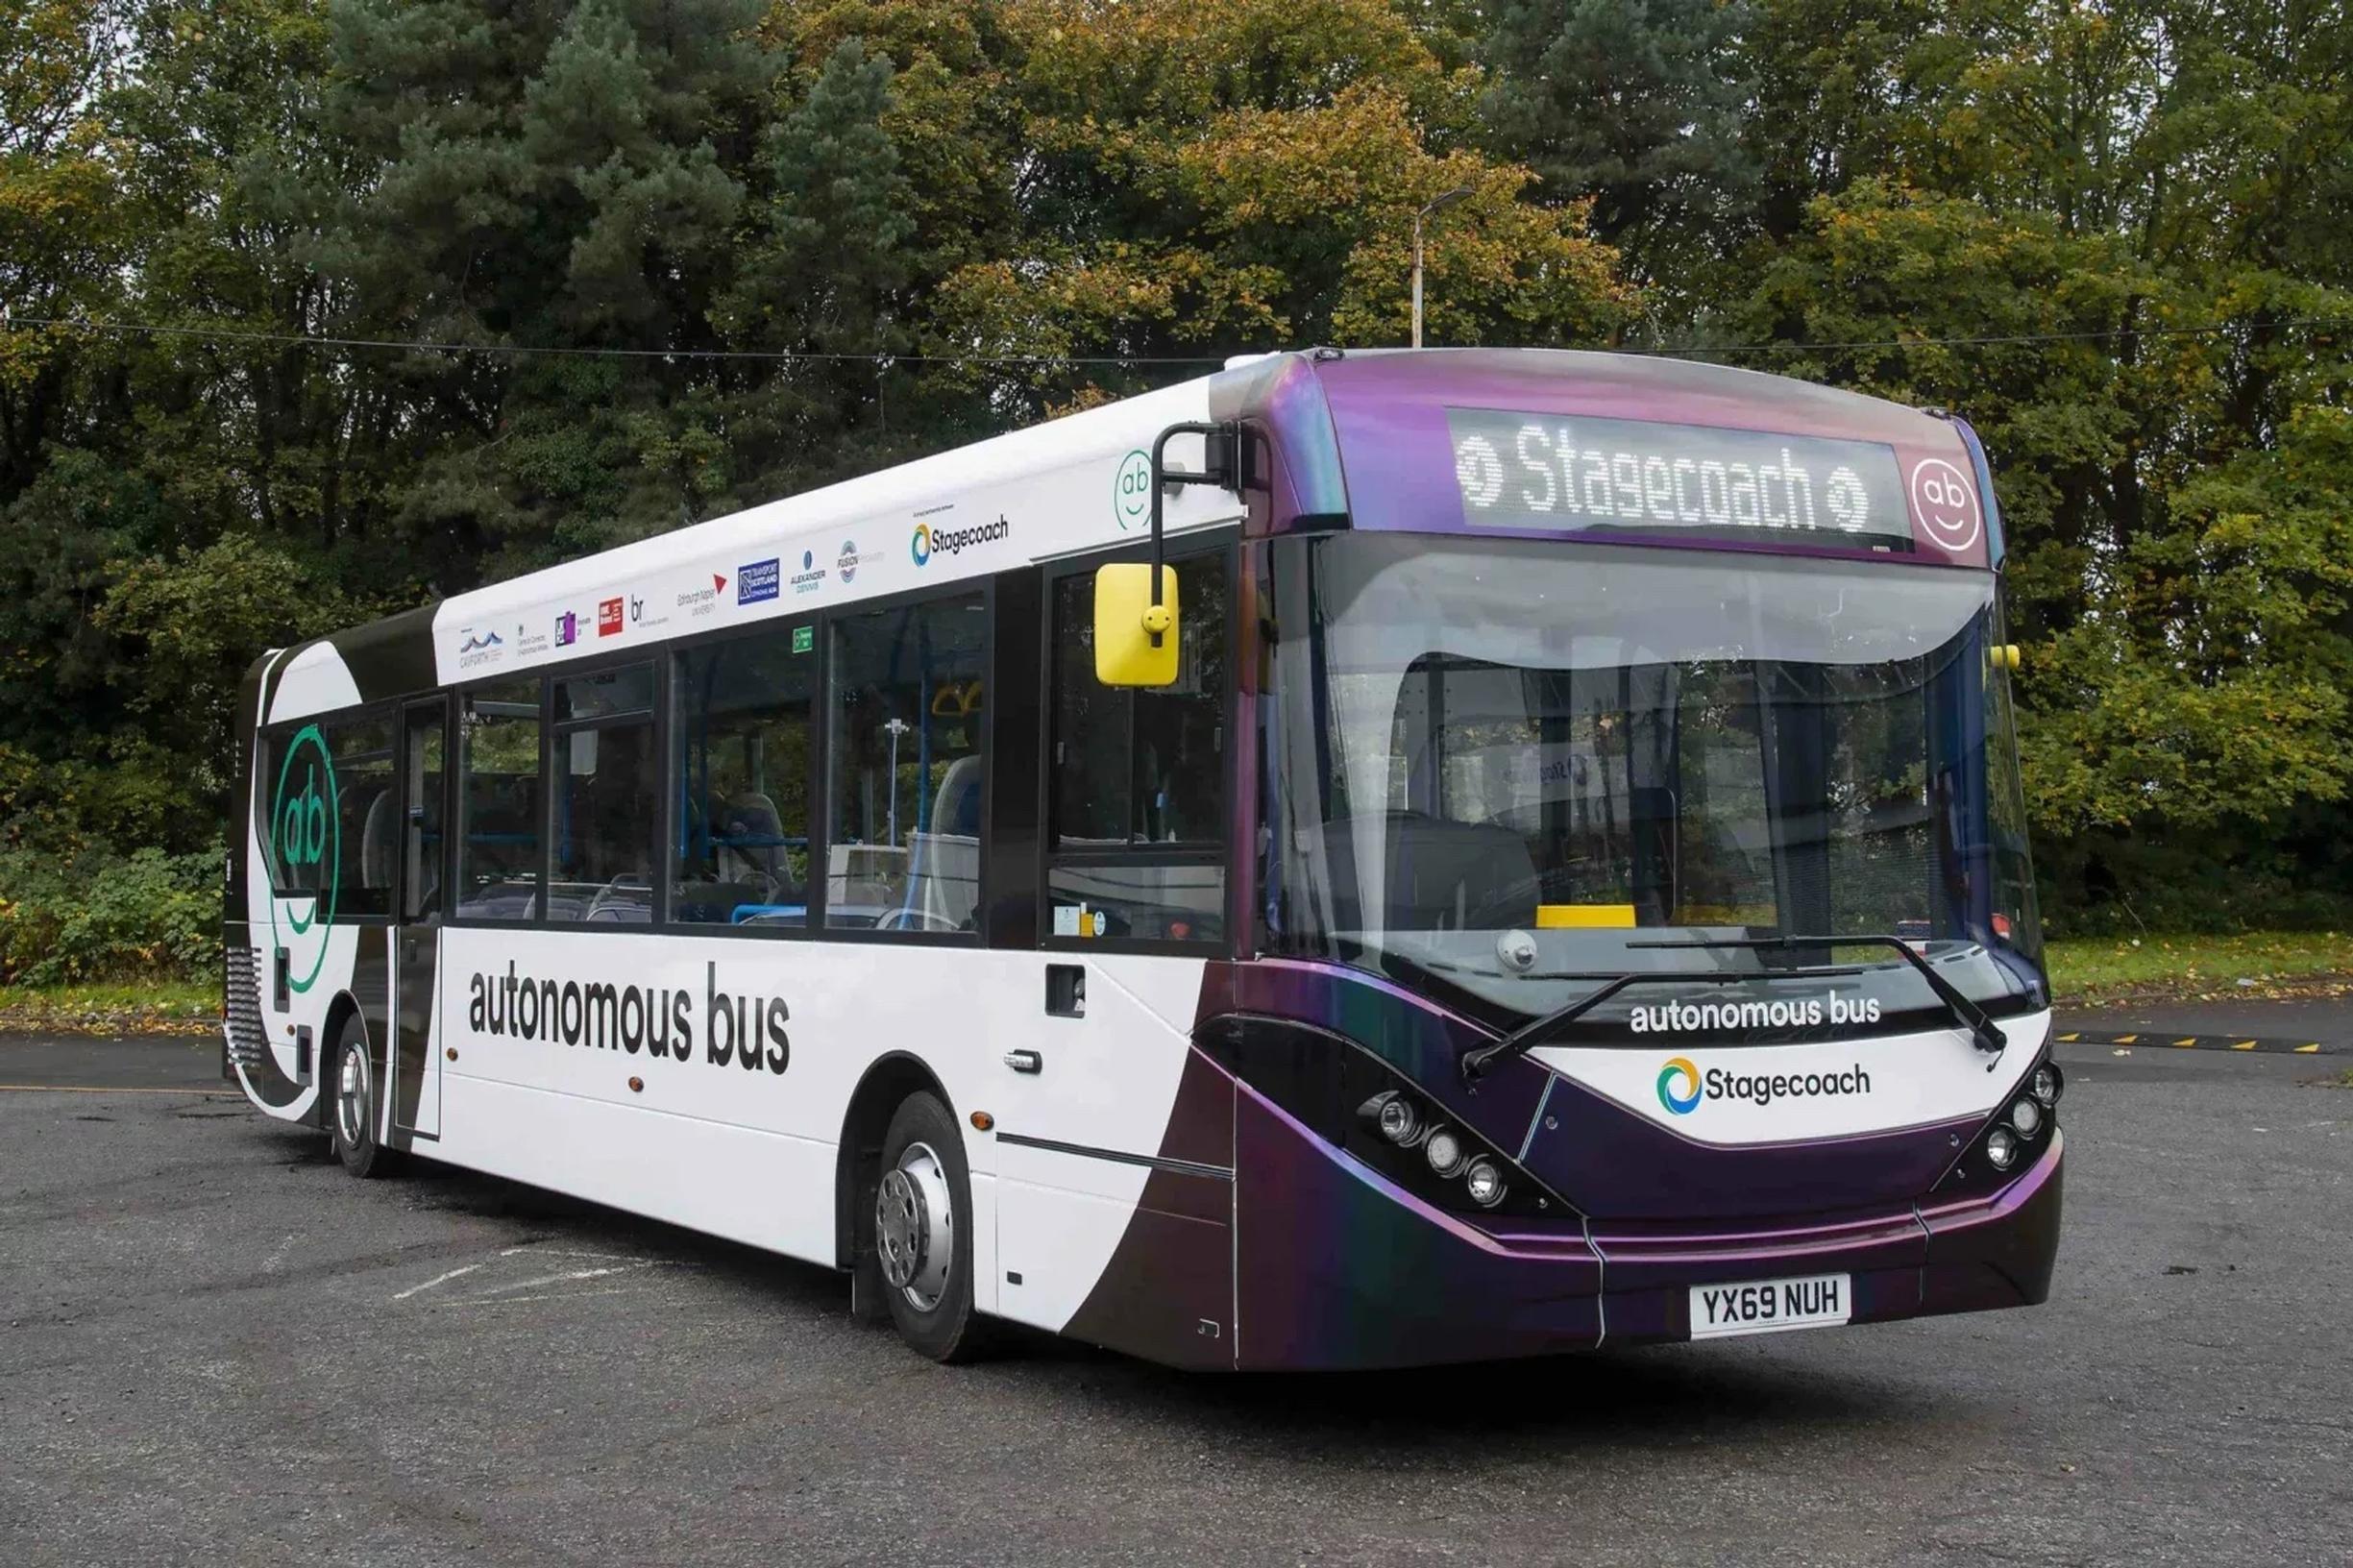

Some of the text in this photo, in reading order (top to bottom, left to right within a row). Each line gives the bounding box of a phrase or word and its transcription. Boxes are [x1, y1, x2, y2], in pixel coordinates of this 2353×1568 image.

[1122, 462, 1148, 495] ab
[1516, 425, 1817, 529] Stagecoach
[1924, 472, 1965, 508] ab
[932, 514, 1008, 554] Stagecoach
[791, 570, 825, 584] ALEXANDER
[284, 763, 326, 865] ab
[469, 960, 791, 1075] autonomous bus
[1630, 990, 1881, 1033] autonomous bus
[1705, 1063, 1871, 1106] Stagecoach
[1703, 1280, 1839, 1324] YX69 NUH
